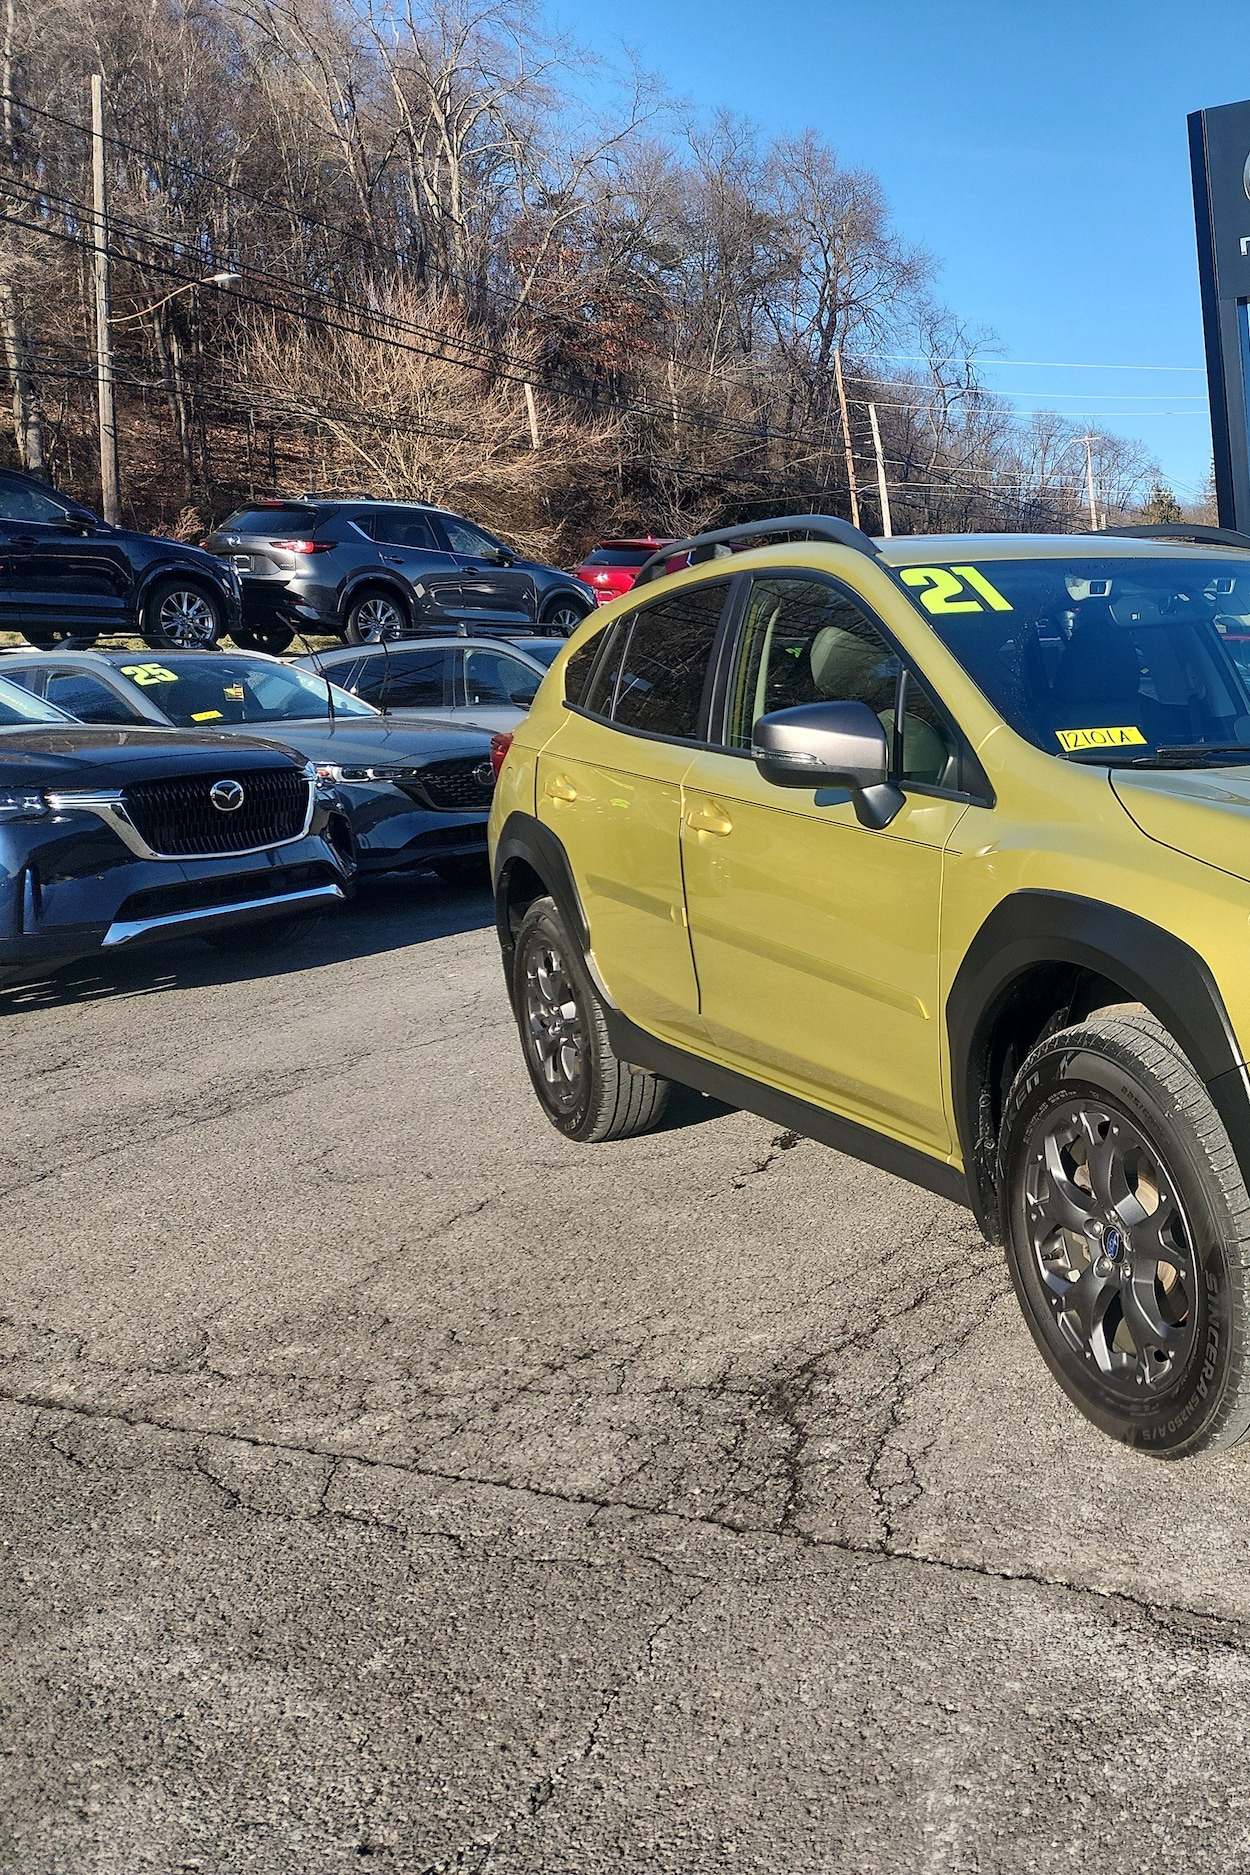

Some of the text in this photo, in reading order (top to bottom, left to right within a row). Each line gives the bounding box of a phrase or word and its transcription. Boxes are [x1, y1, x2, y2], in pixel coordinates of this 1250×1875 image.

[900, 566, 1014, 615] 21
[120, 663, 179, 686] 25
[1196, 1269, 1221, 1400] SINCERA
